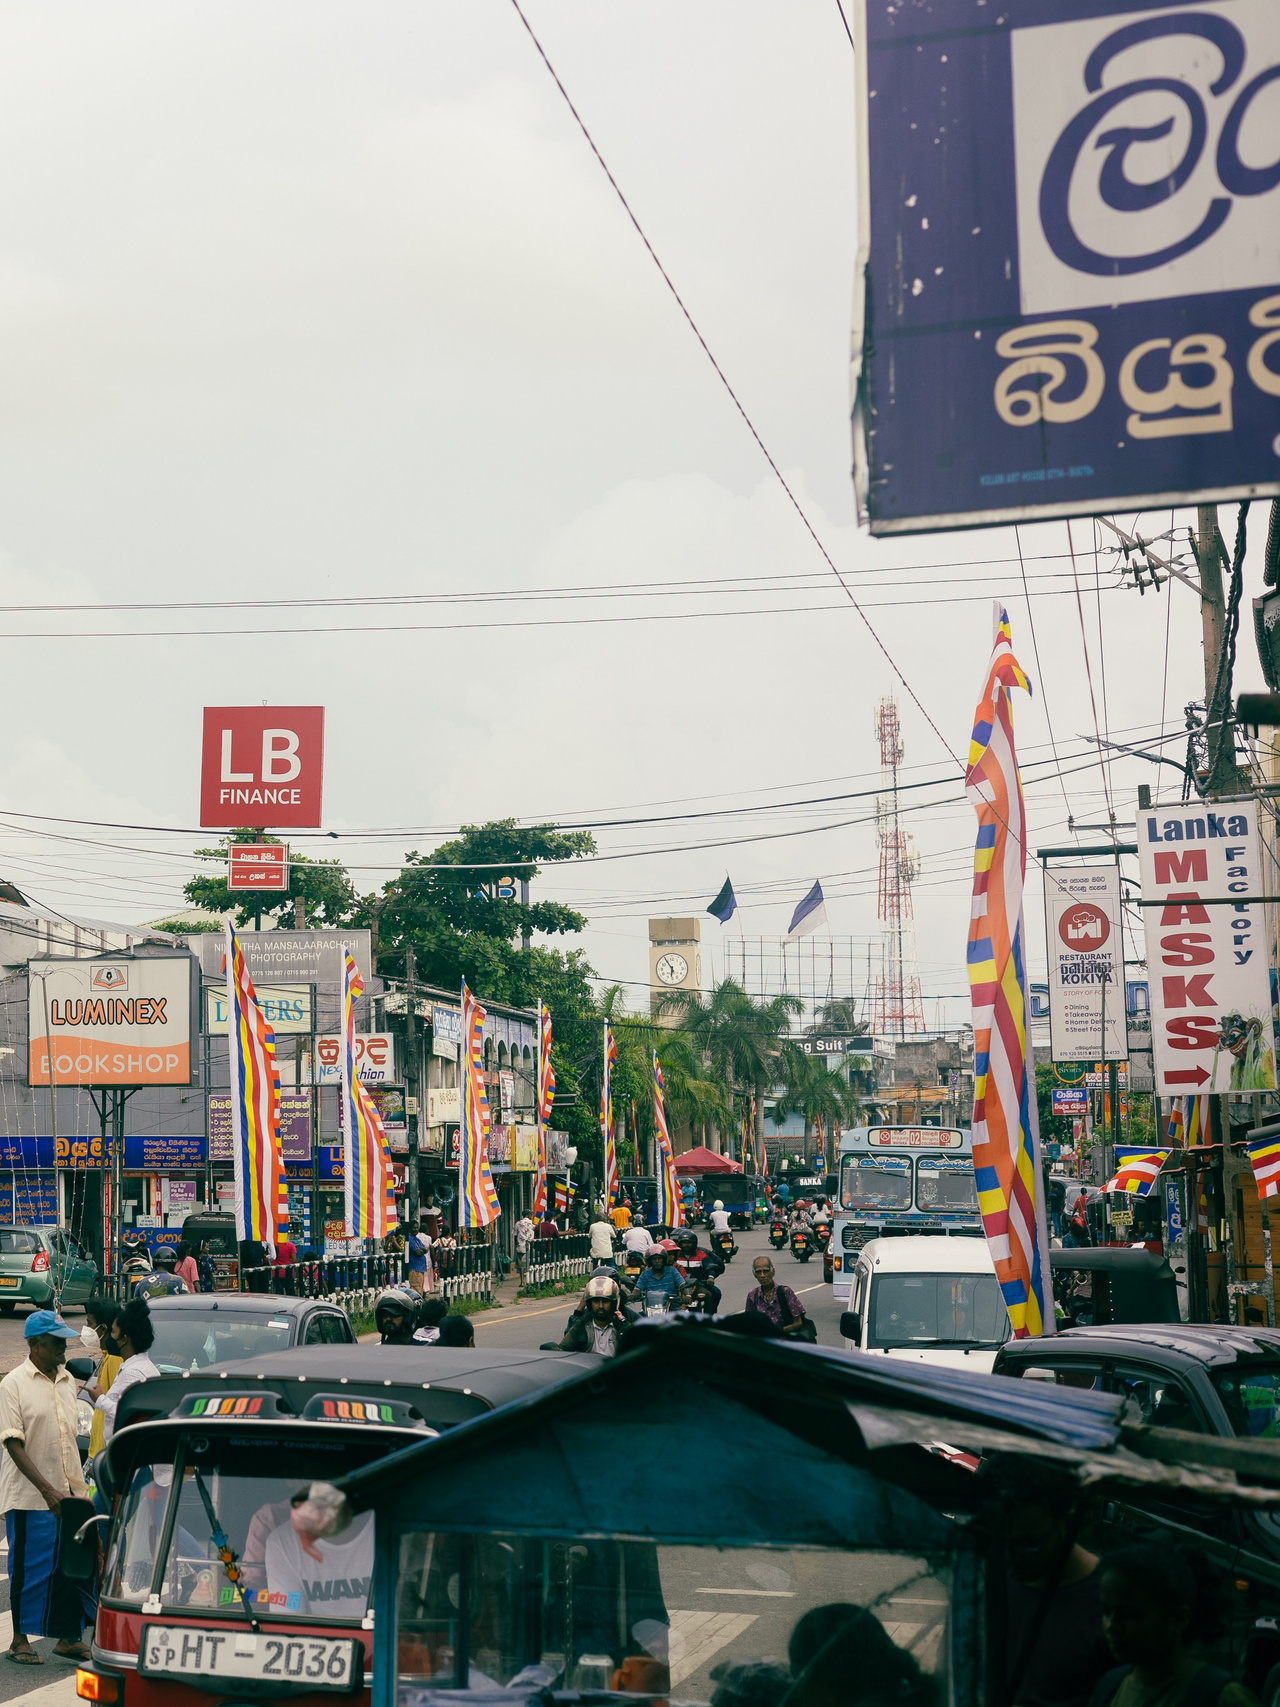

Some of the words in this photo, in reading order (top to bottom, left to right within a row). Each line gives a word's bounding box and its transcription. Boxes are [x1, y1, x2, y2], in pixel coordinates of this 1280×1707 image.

[222, 729, 302, 783] LB
[220, 789, 301, 805] FINANCE
[1147, 813, 1249, 843] Lanka
[1225, 846, 1254, 966] Factory
[250, 952, 322, 962] PHOTOGRAPHY
[1060, 953, 1112, 961] RESTAURANT
[1154, 849, 1220, 1050] MASKS
[1062, 974, 1113, 984] KOKIYA
[52, 998, 168, 1026] LUMINEX
[816, 1040, 842, 1051] Suit
[40, 1053, 180, 1074] BOOKSHOP
[910, 1132, 920, 1145] 02
[149, 1645, 176, 1666] SP
